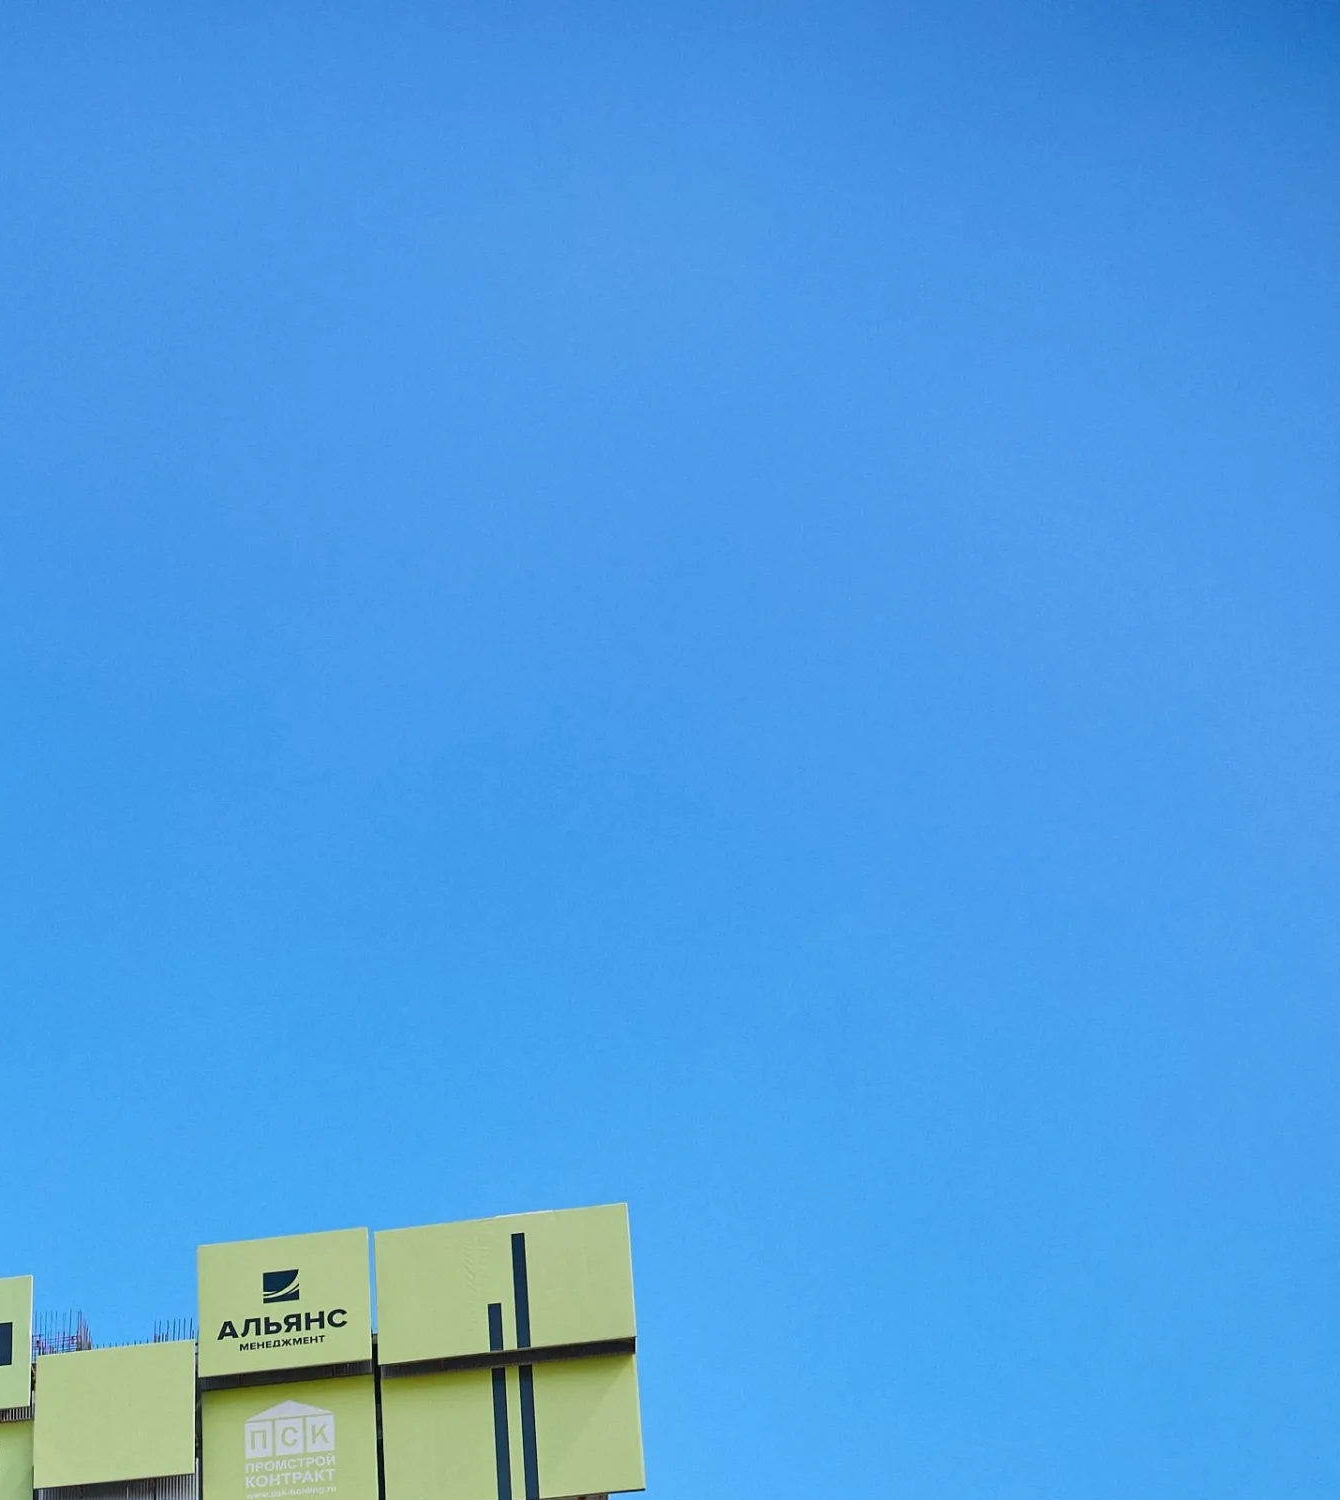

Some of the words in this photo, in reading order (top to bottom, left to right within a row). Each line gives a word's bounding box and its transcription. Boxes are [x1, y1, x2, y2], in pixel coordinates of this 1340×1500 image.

[216, 1308, 348, 1341] АЛЬЯНС
[239, 1335, 326, 1352] МЕНЕДЖМЕНТ
[249, 1422, 330, 1451] ПСК
[245, 1453, 336, 1473] ПРОМСТРОЙ
[245, 1468, 336, 1489] КОНТРАКТ
